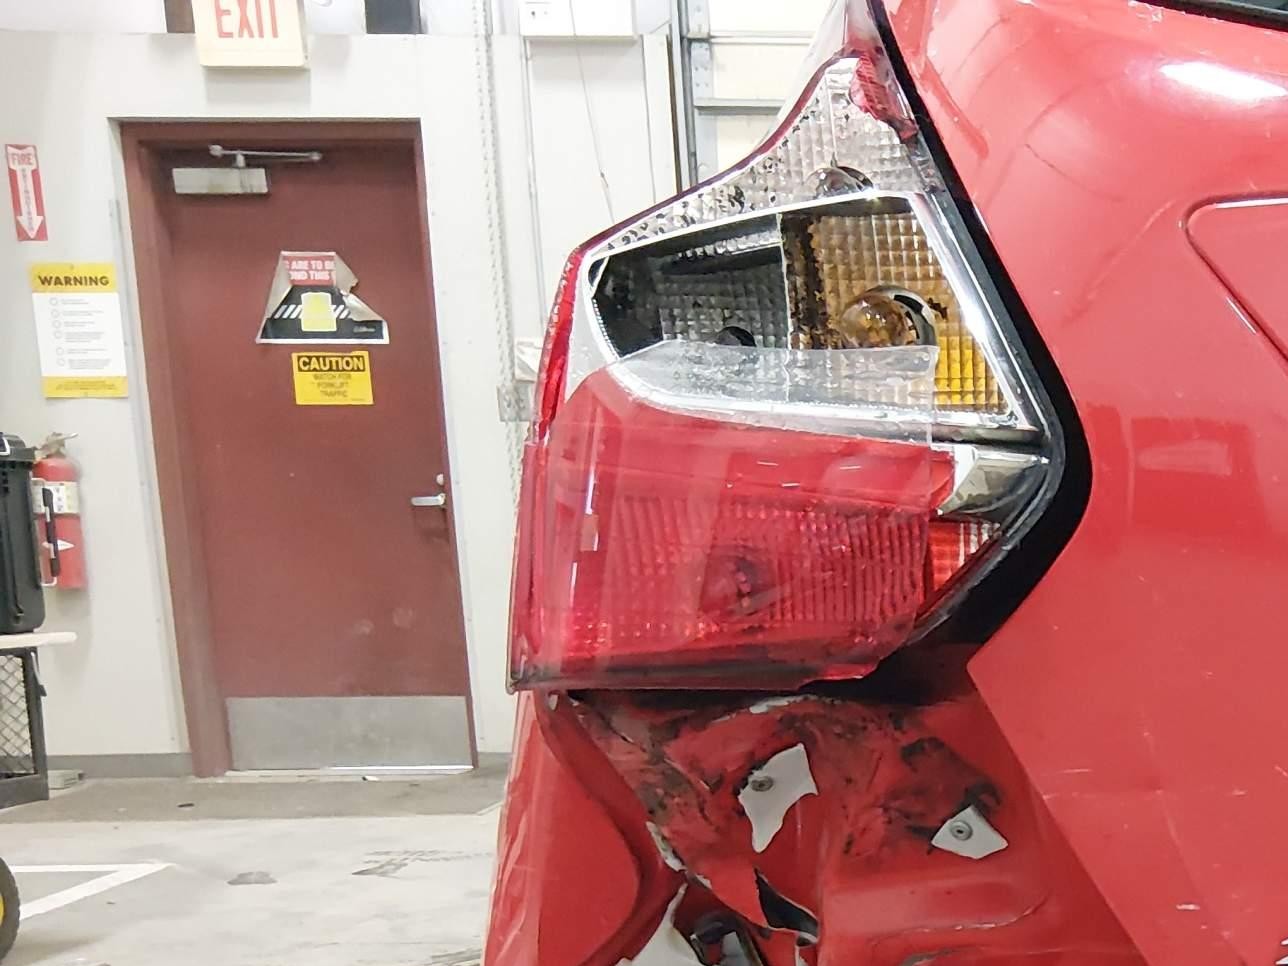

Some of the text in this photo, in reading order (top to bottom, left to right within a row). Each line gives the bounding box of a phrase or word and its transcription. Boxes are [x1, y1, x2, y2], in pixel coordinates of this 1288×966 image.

[214, 0, 279, 38] EXIT
[11, 152, 34, 166] FIRE
[38, 275, 110, 287] WARNING
[299, 356, 364, 371] CAUTION
